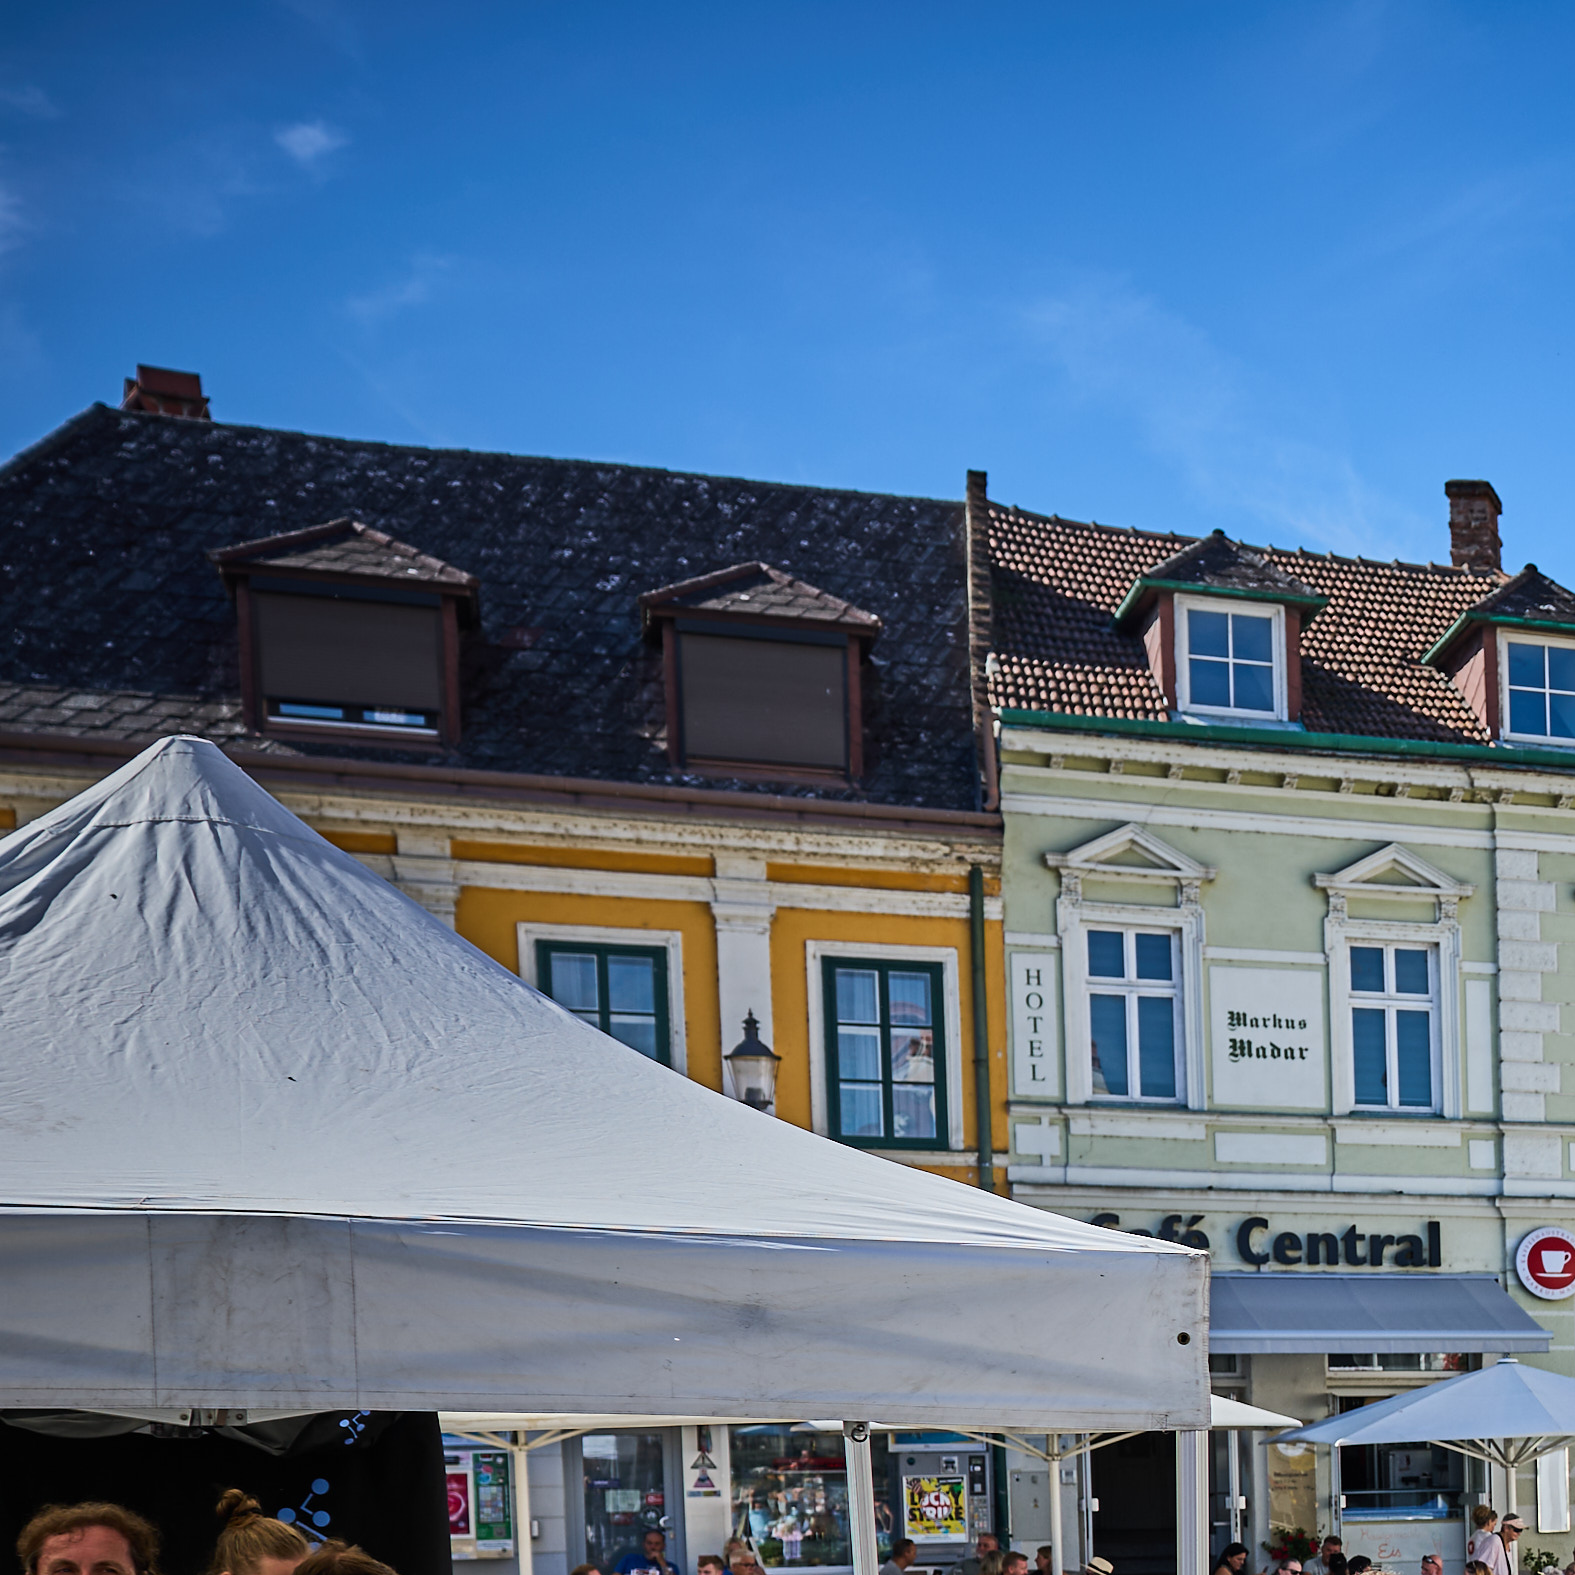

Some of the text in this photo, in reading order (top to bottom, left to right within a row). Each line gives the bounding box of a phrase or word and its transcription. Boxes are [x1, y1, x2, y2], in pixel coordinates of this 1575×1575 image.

[1025, 968, 1045, 1082] HOTEL
[1227, 1010, 1307, 1031] Markus
[1228, 1038, 1308, 1062] Madar
[1090, 1212, 1441, 1267] fé Central
